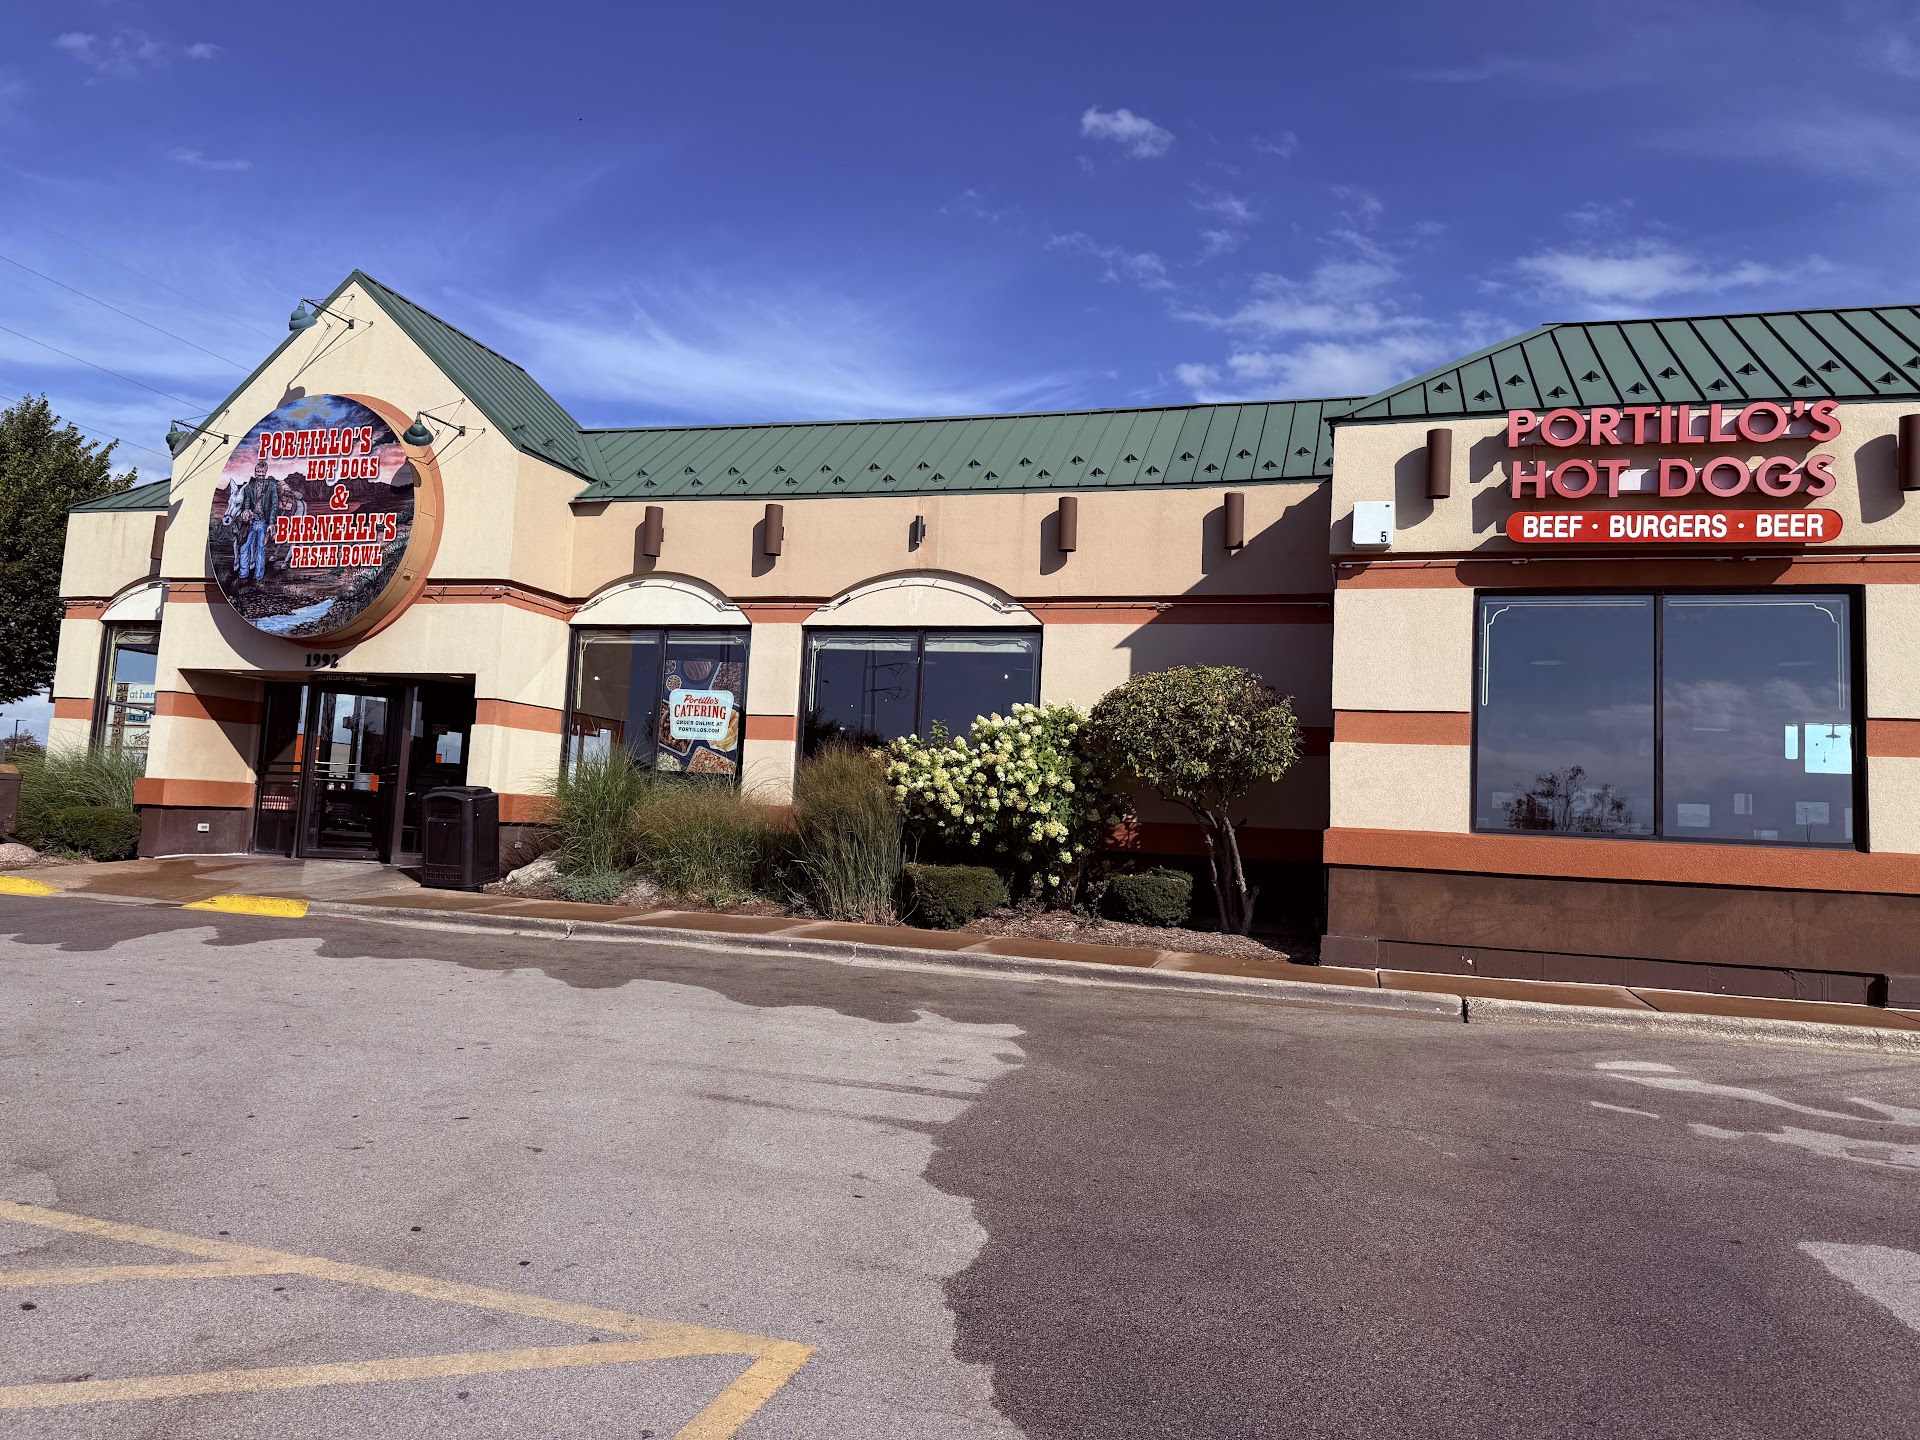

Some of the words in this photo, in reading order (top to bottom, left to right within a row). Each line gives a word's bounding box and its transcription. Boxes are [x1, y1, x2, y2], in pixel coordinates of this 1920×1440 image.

[1507, 400, 1842, 448] PORTILLO'S
[258, 426, 373, 459] PORTILLO'S
[306, 459, 337, 480] HOT
[339, 457, 379, 479] DOGS
[1511, 458, 1631, 499] HOT
[1658, 454, 1837, 498] DOGS
[330, 484, 349, 510] &
[275, 513, 397, 543] BARNELLI'S
[1380, 531, 1387, 543] 5
[1523, 515, 1583, 538] BEEF
[1609, 514, 1727, 538] BURGERS
[1756, 514, 1823, 537] BEER
[290, 545, 338, 568] PASTA
[341, 544, 382, 567] BOWL
[305, 653, 339, 669] 1992
[129, 690, 138, 699] at
[684, 694, 719, 704] Portillo's
[673, 704, 727, 720] CATERING
